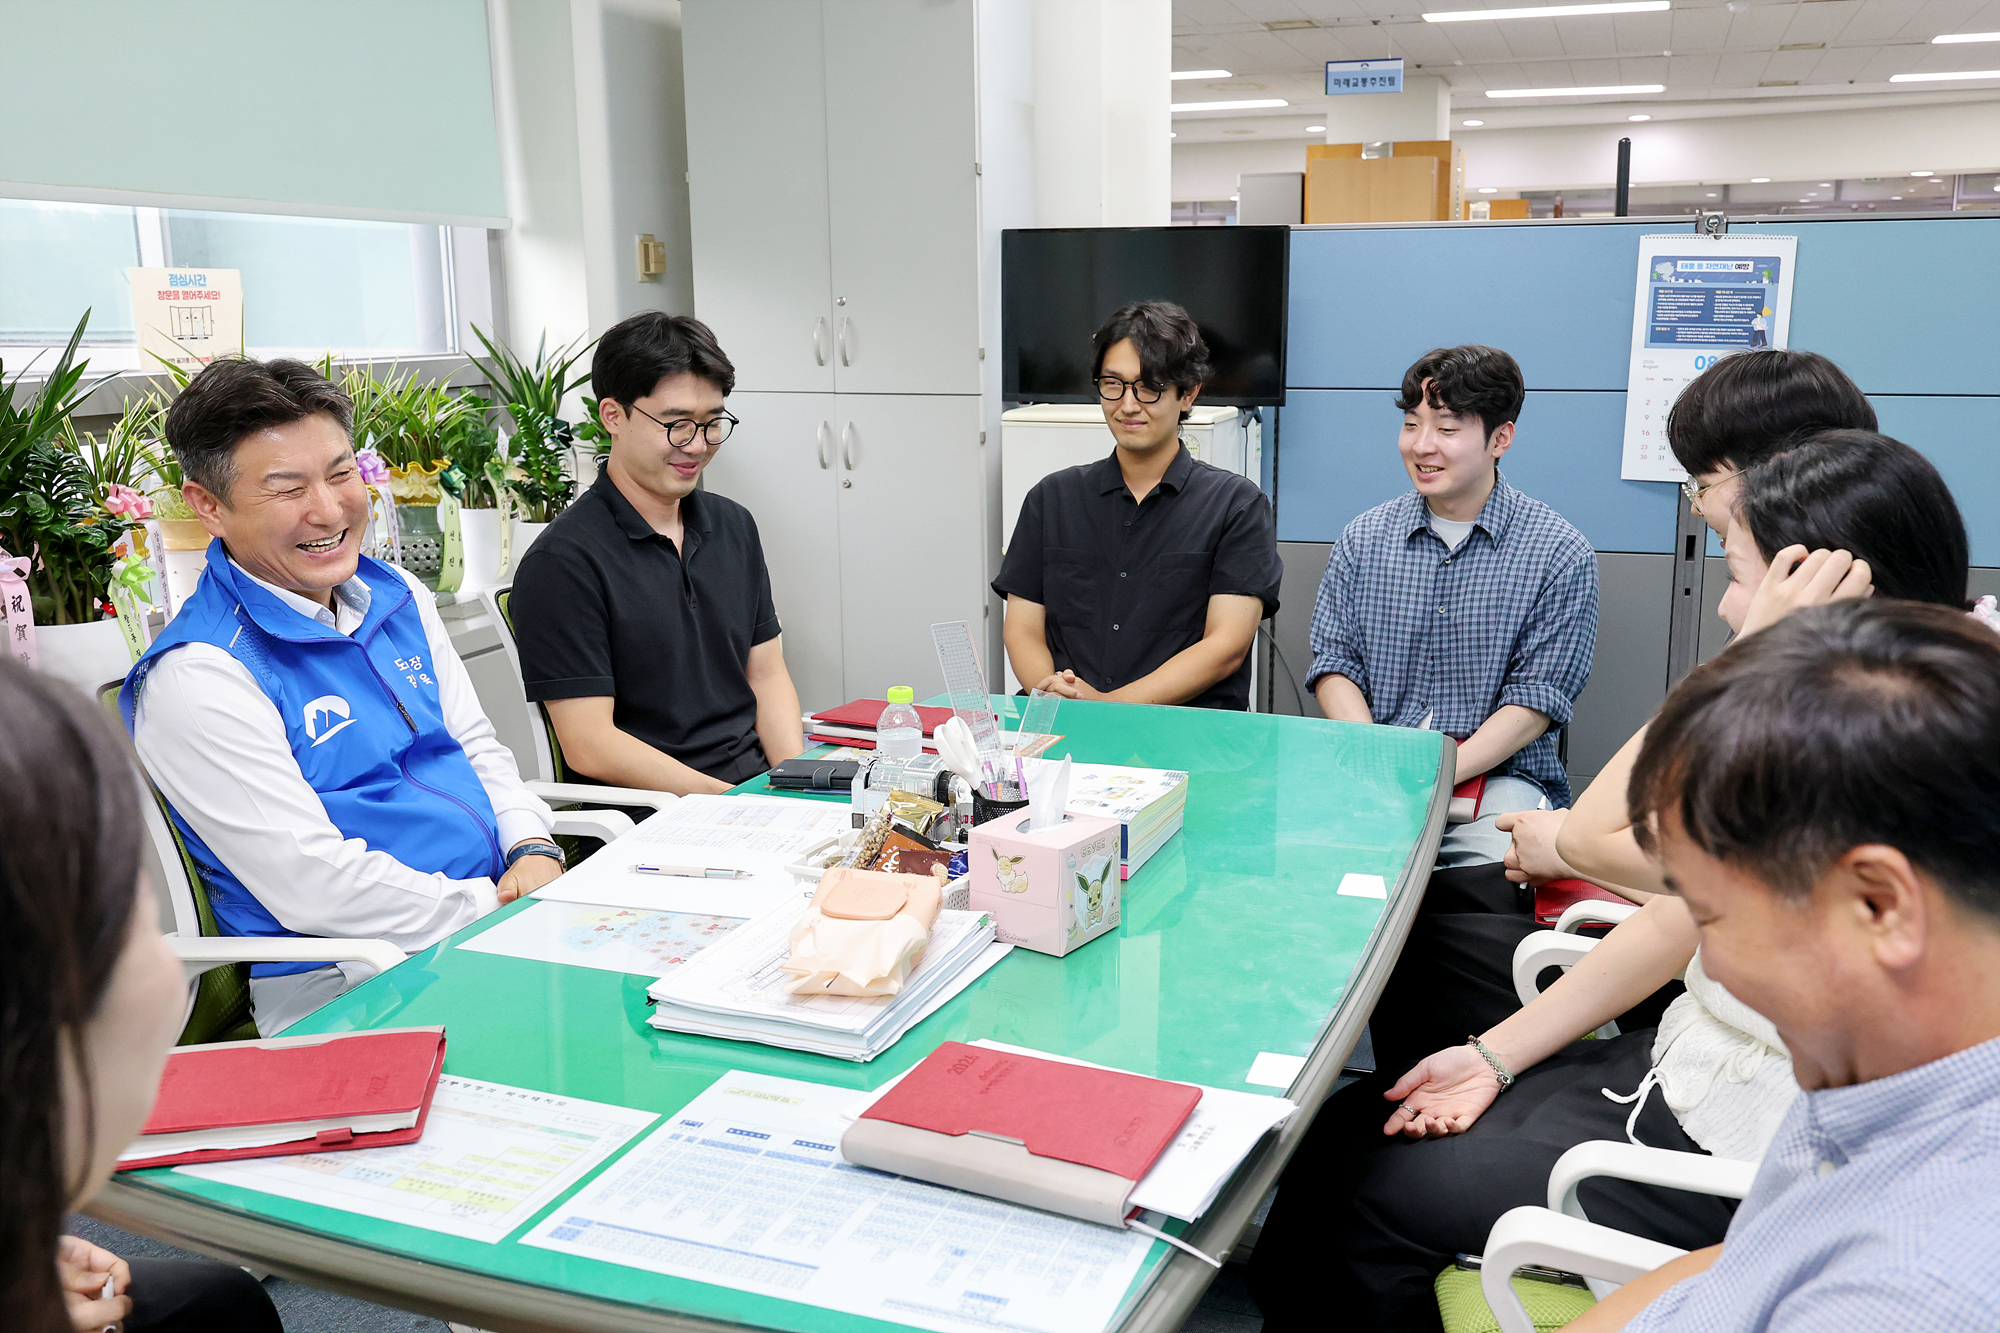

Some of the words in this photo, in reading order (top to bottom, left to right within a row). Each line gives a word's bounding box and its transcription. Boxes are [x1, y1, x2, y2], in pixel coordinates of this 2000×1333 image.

[1333, 76, 1396, 88] 미래교통추진팀
[1705, 262, 1734, 270] 자연재난
[1734, 262, 1750, 270] 예방
[168, 273, 207, 287] 점심시간
[157, 290, 180, 301] 창문을
[181, 290, 221, 301] 열어주세요!
[1080, 837, 1106, 858] EEVEE
